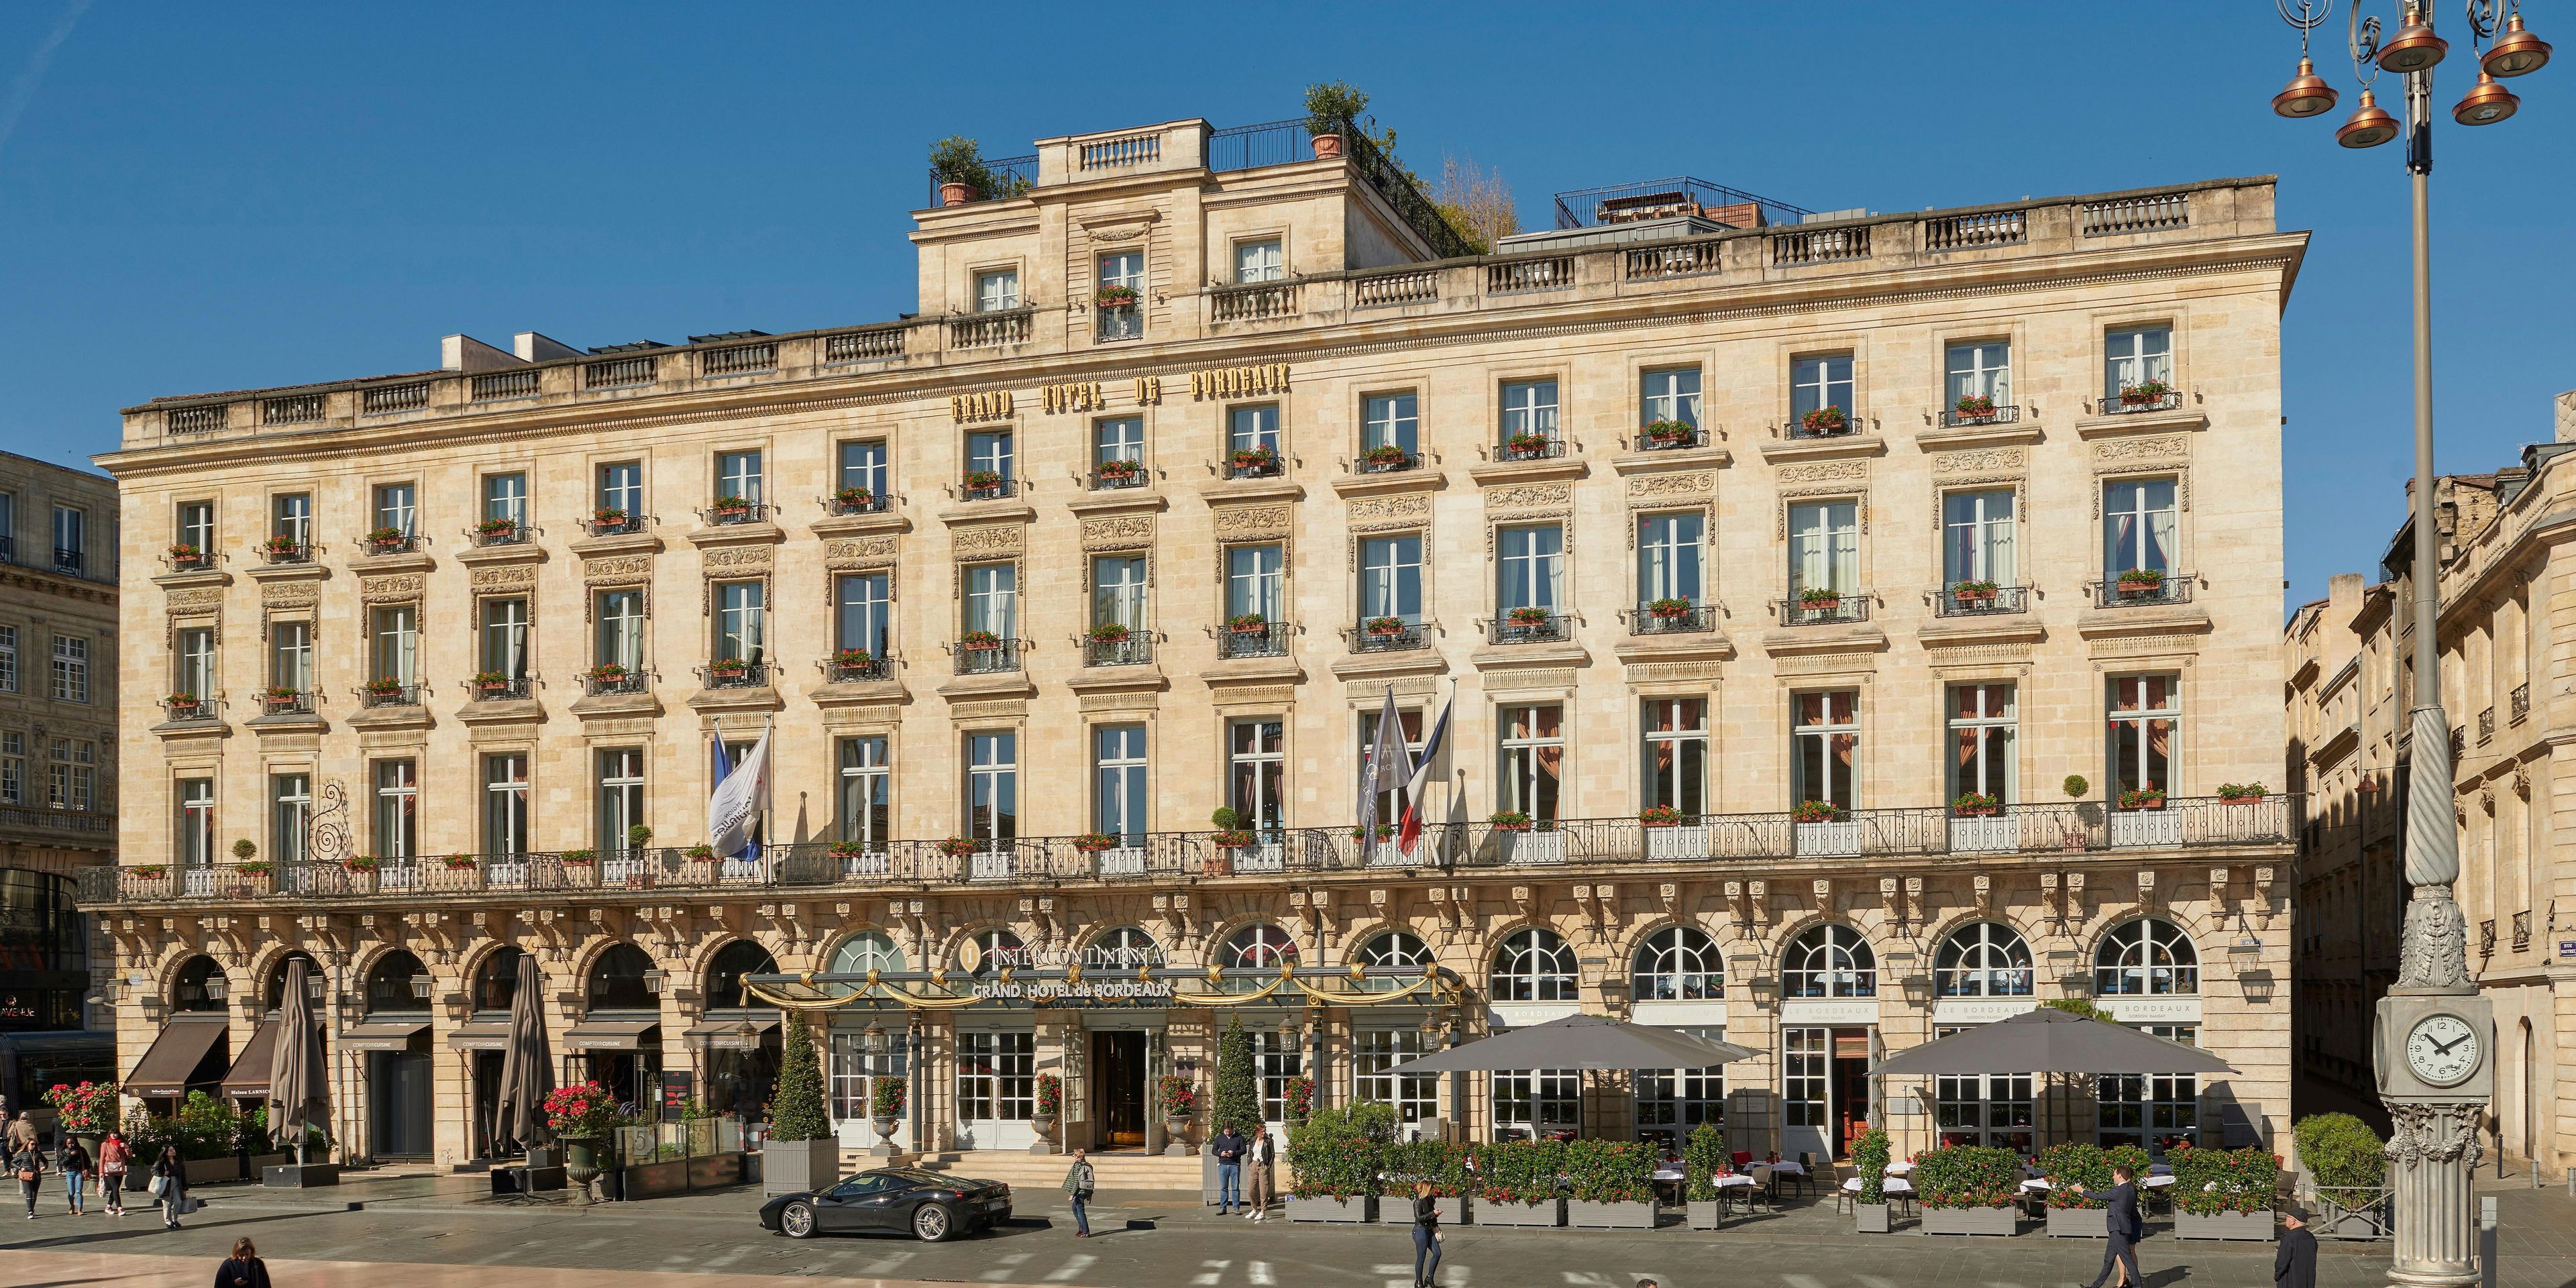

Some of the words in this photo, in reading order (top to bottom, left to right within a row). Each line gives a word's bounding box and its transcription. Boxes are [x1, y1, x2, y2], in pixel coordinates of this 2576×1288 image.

[950, 389, 1012, 419] GRAND
[1040, 380, 1102, 410] HOTEL
[1134, 375, 1158, 402] DE
[1189, 362, 1289, 396] BORDEAUX
[992, 947, 1170, 965] INTERCONTINENTAL
[971, 985, 1021, 998] GRAND
[1028, 984, 1073, 998] HOTEL
[1075, 985, 1091, 998] de
[1094, 983, 1172, 998] BORDEAUX
[1515, 1010, 1570, 1018] BORDEAUX
[2437, 1022, 2447, 1030] 12
[2418, 1034, 2426, 1042] 10
[2414, 1044, 2422, 1053] 9
[2418, 1055, 2426, 1063] 8
[2459, 1055, 2466, 1063] 4
[2426, 1064, 2434, 1072] 7
[2438, 1067, 2446, 1075] 6
